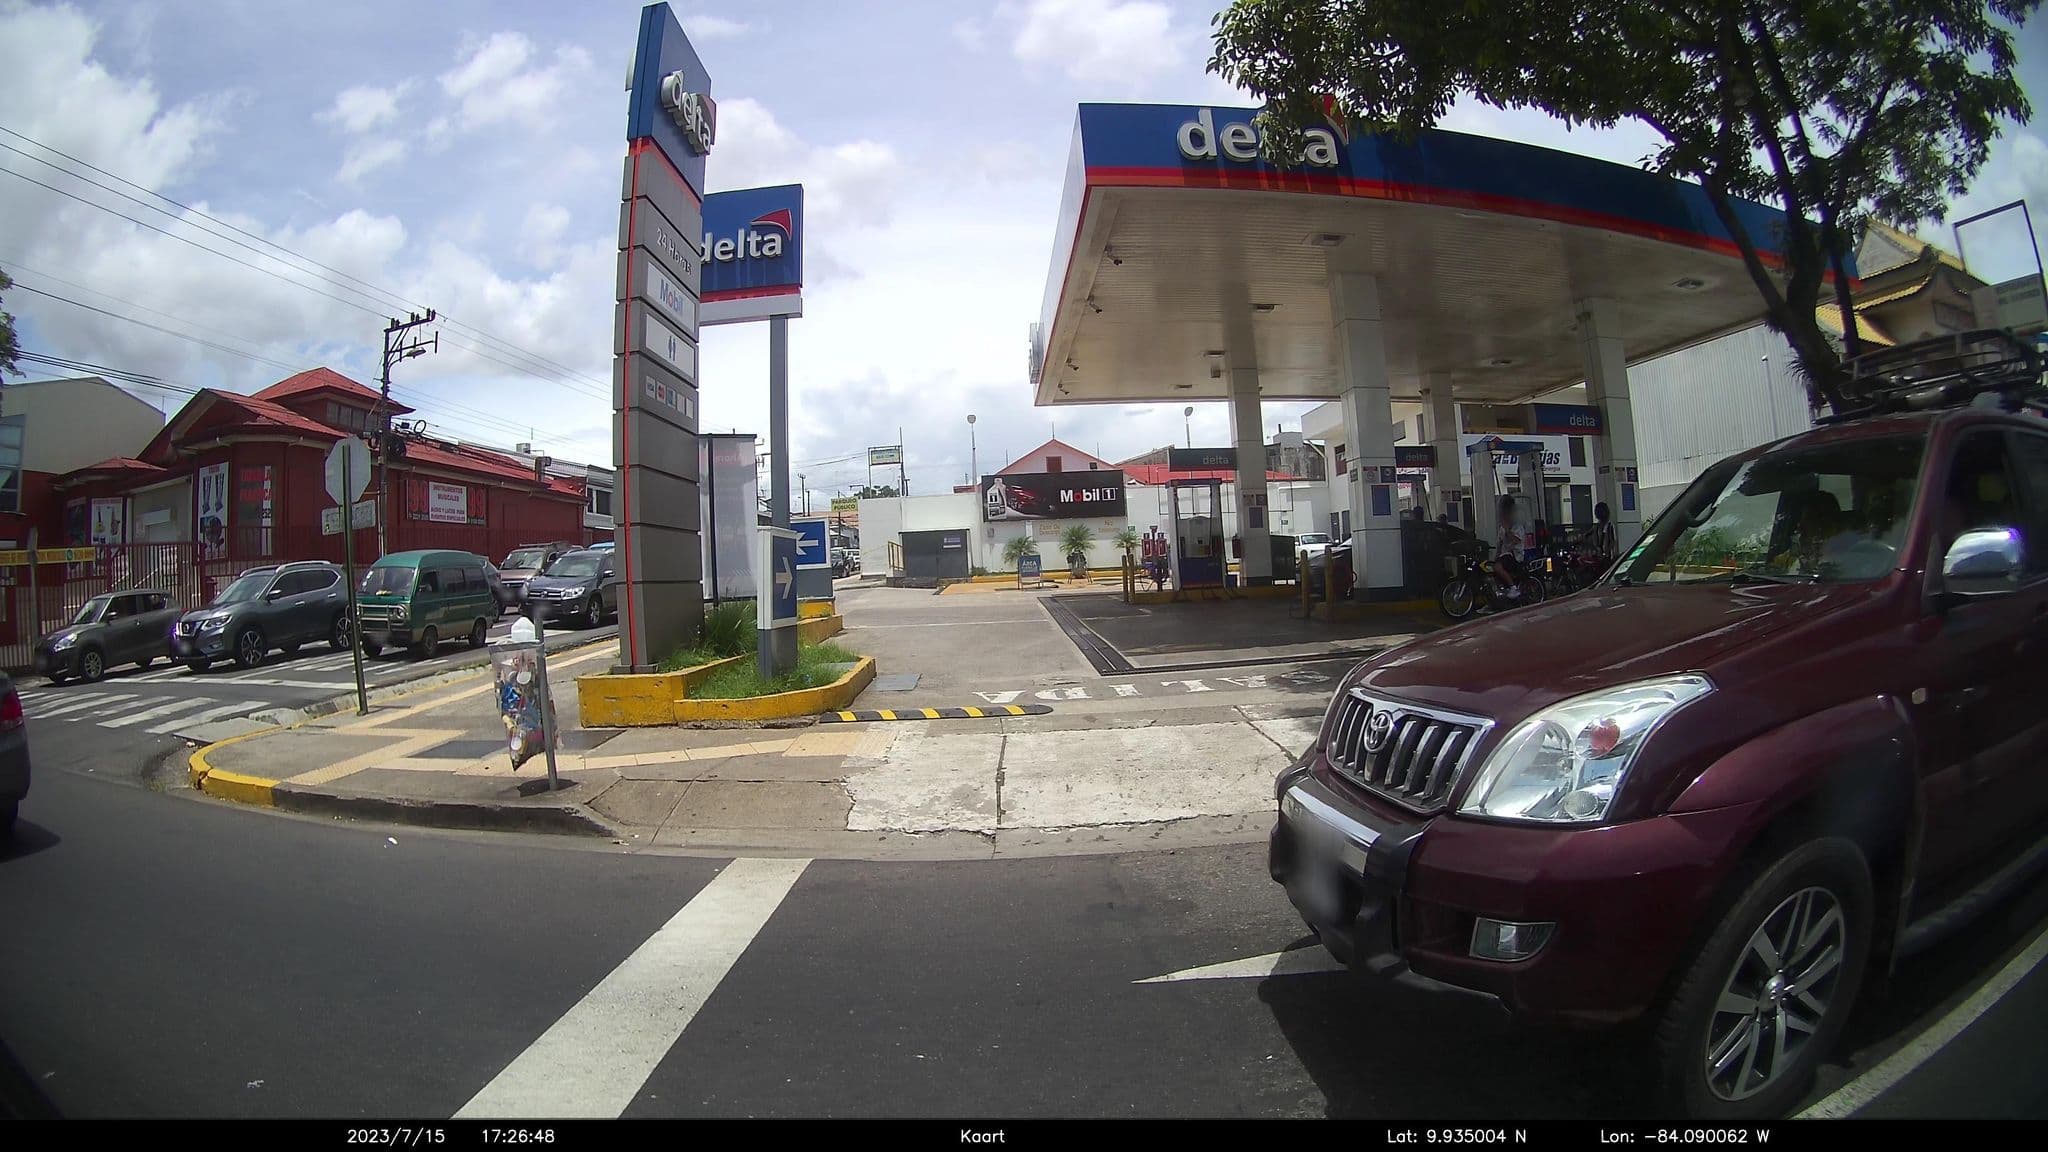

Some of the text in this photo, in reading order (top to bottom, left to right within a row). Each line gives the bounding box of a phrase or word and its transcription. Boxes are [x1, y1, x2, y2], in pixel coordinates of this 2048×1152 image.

[661, 70, 711, 156] delta
[1176, 106, 1339, 166] dea
[657, 226, 668, 252] 24
[659, 278, 684, 316] Mobil
[1570, 414, 1596, 427] delta
[1203, 455, 1230, 465] delta
[1060, 488, 1100, 503] Mobil
